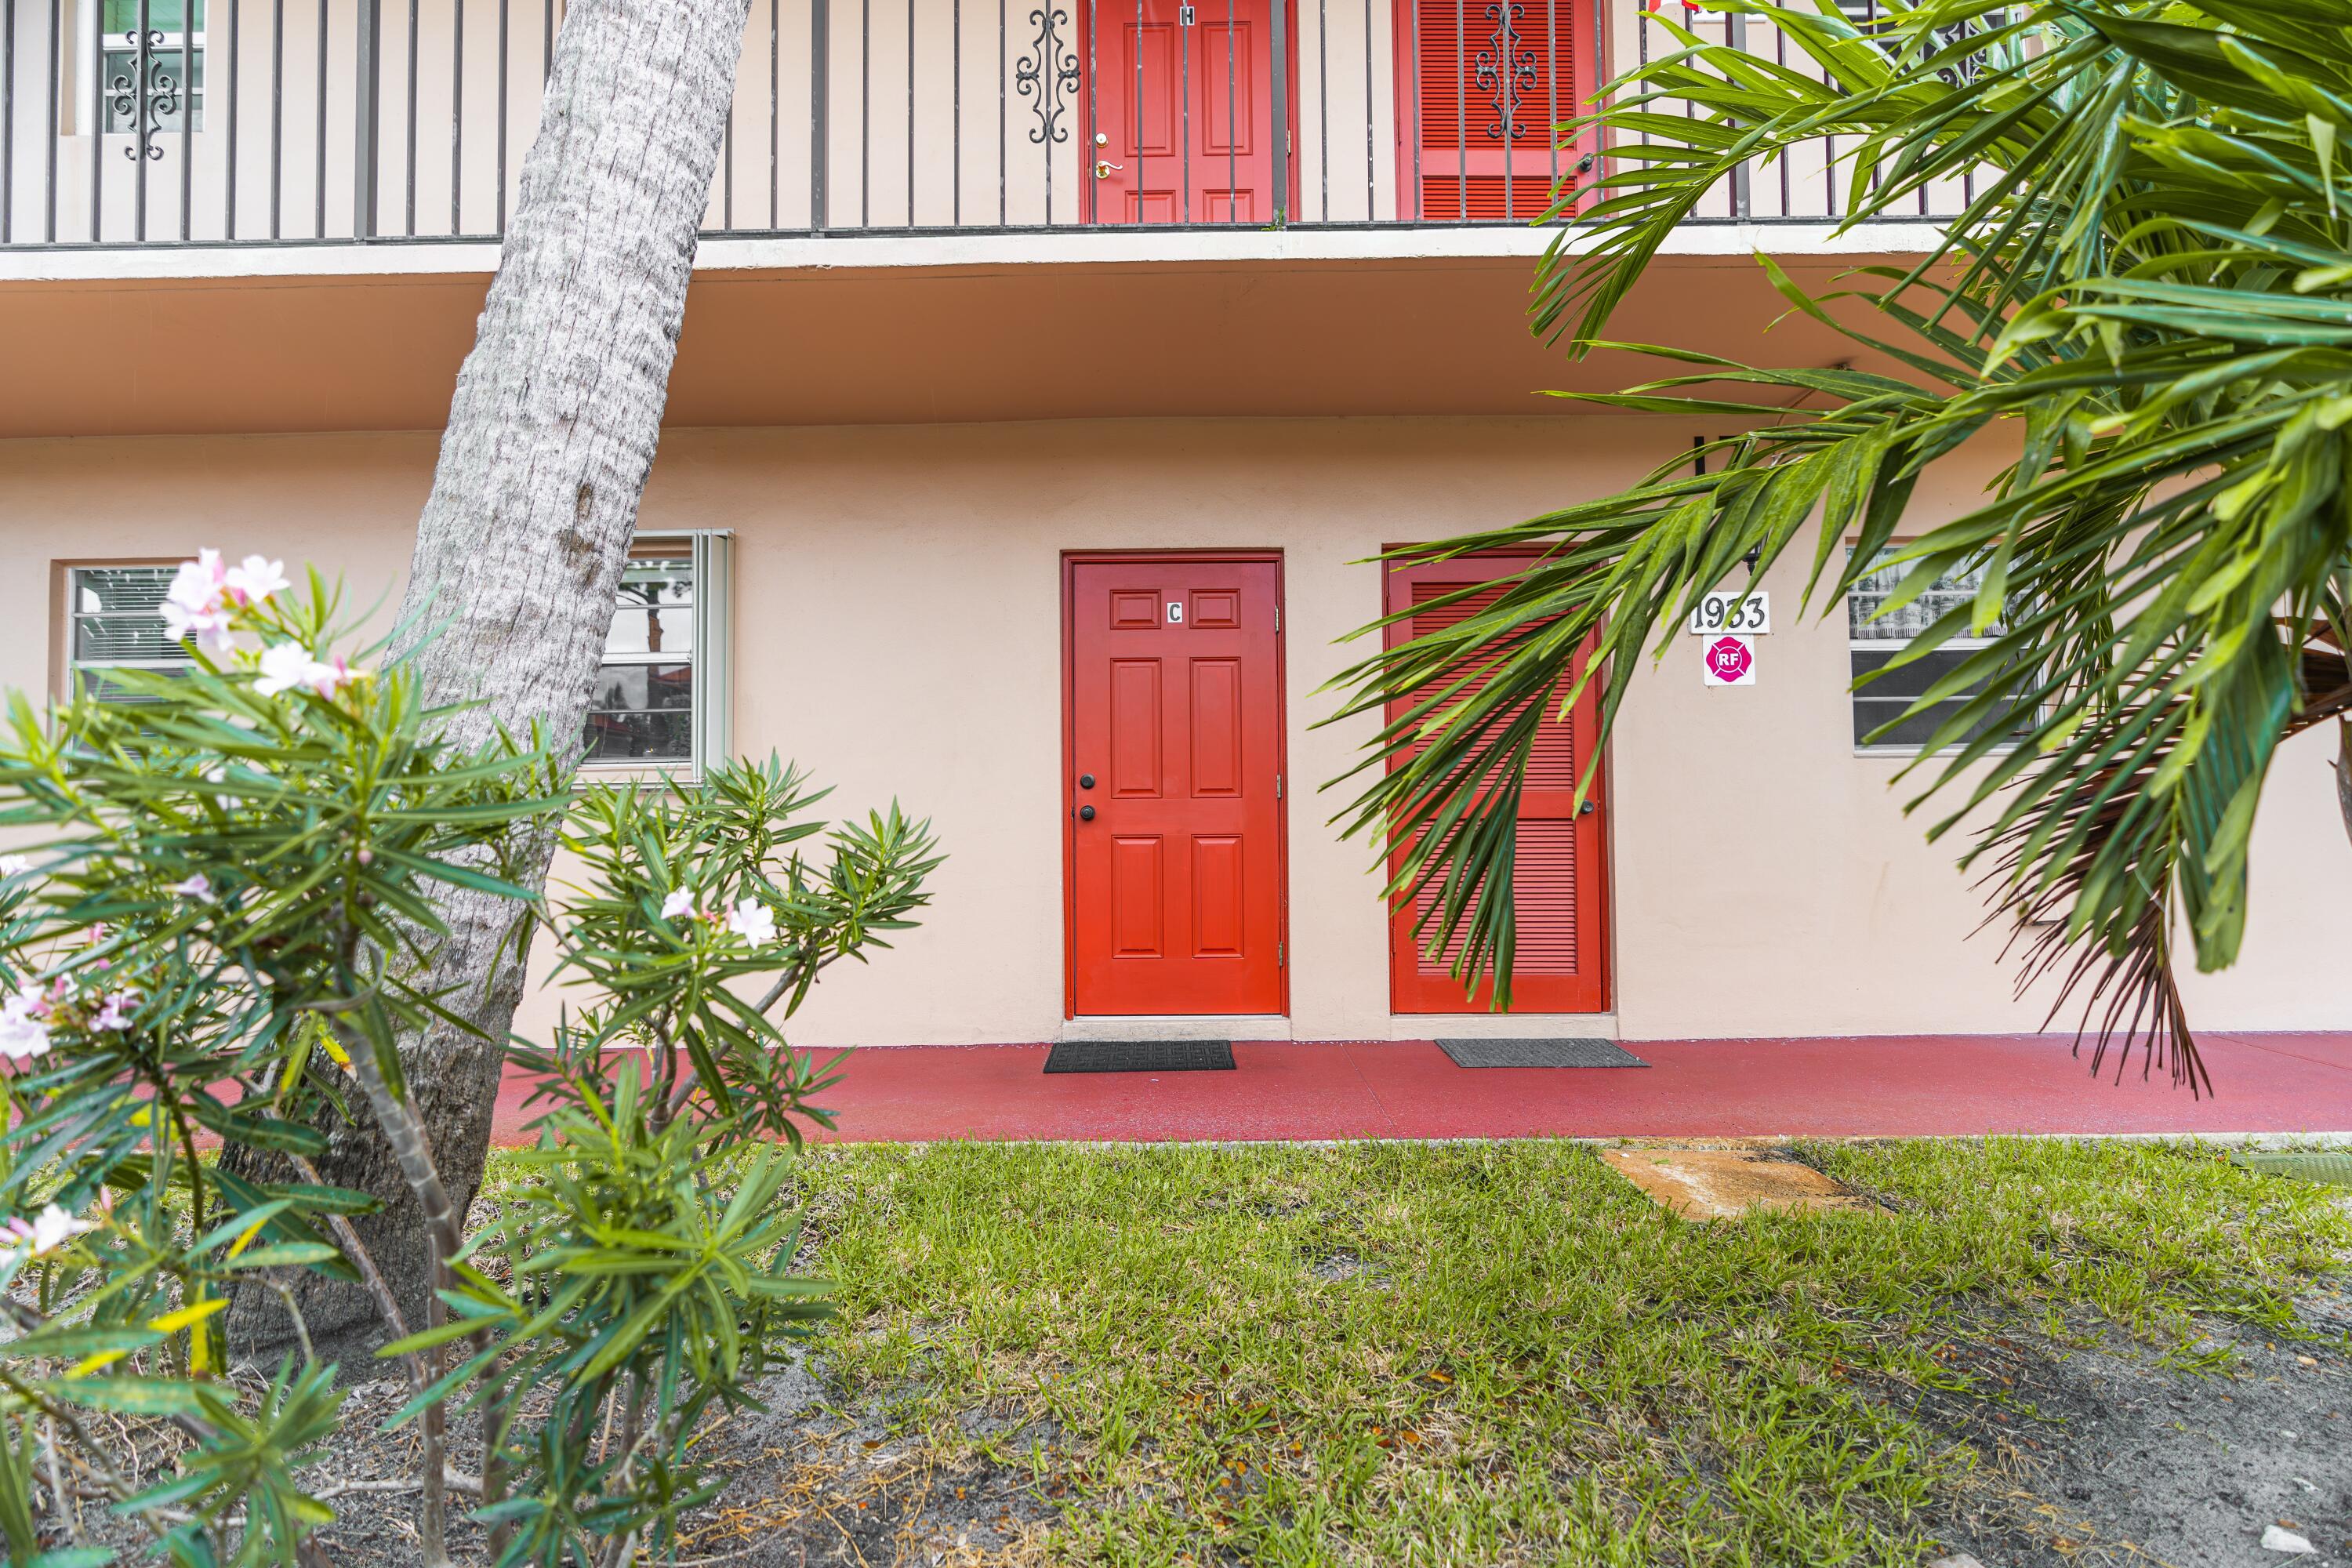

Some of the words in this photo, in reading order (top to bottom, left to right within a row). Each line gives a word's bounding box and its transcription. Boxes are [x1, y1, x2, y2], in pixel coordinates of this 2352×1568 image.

[1181, 8, 1193, 24] H
[1169, 603, 1181, 622] C
[1694, 597, 1766, 629] 1933
[1719, 653, 1740, 666] RF
